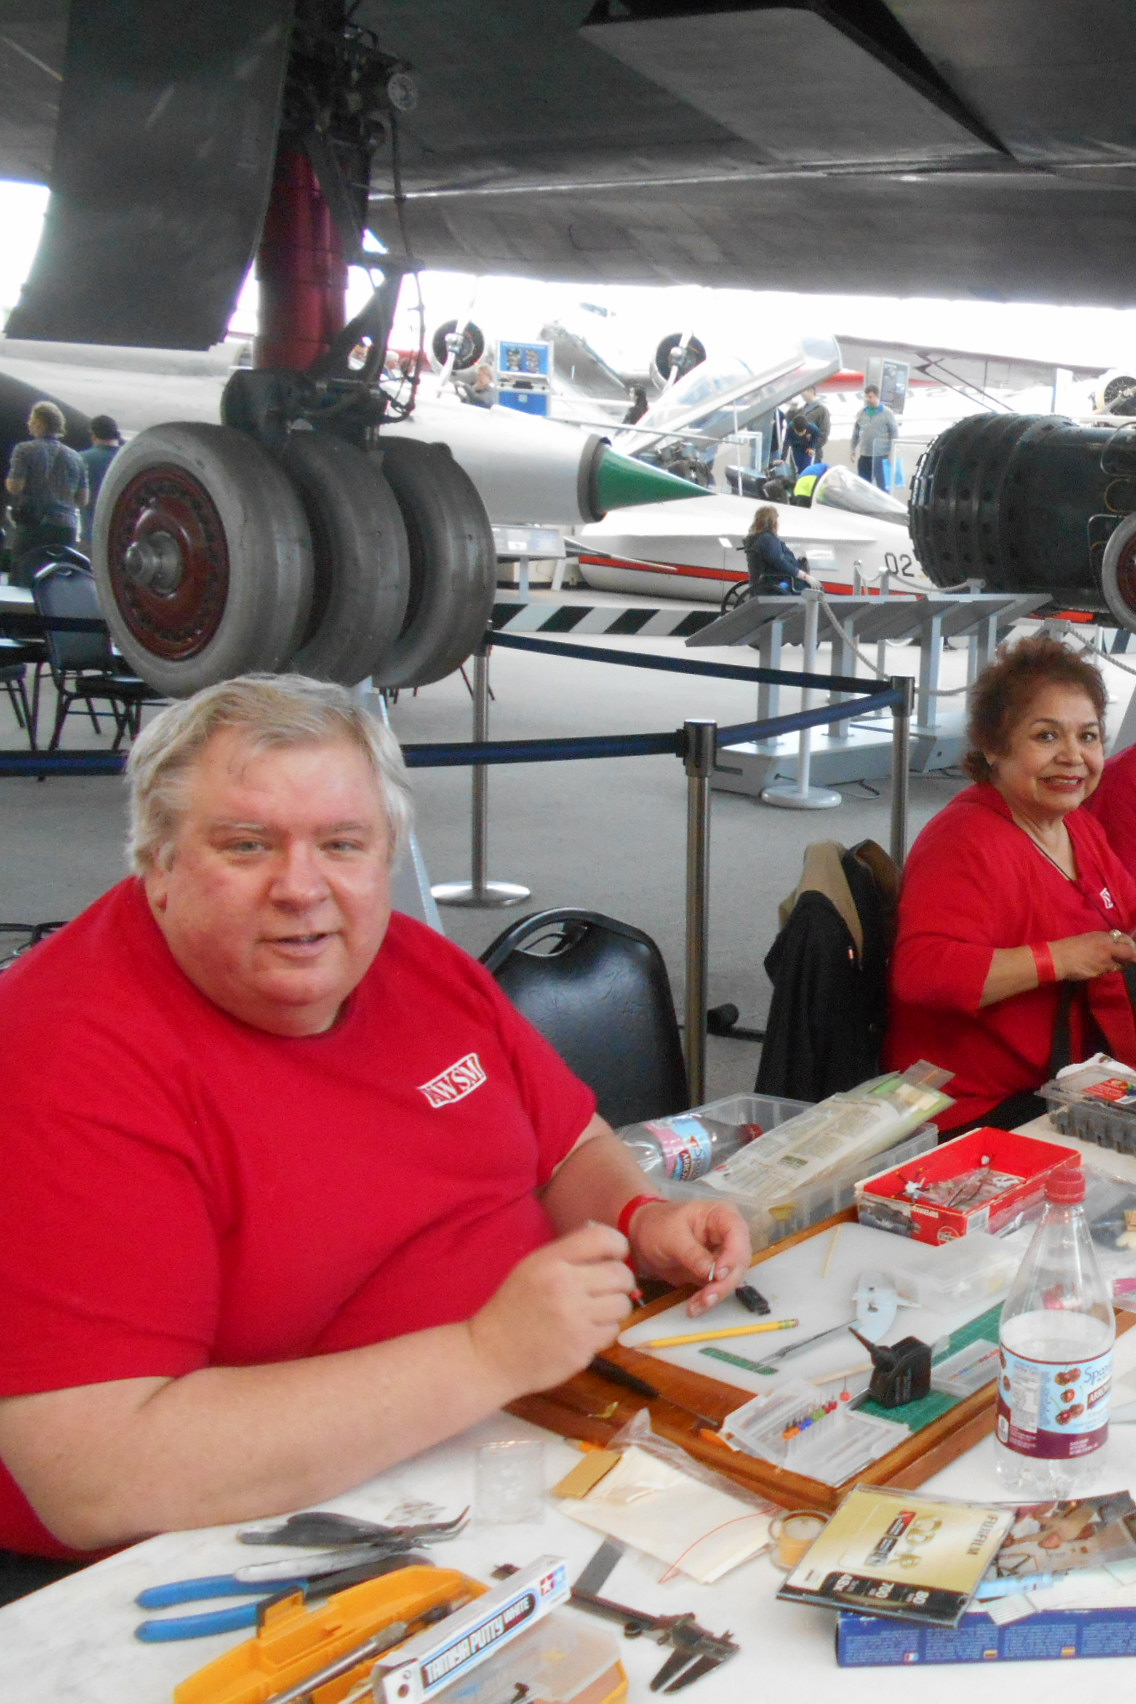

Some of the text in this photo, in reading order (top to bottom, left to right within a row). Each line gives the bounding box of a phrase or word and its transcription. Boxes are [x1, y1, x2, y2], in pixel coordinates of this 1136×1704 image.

[885, 553, 914, 577] 02
[876, 1582, 895, 1599] 700
[913, 1590, 930, 1605] 80
[426, 1596, 530, 1684] TAMIYA PUTTY WHITE
